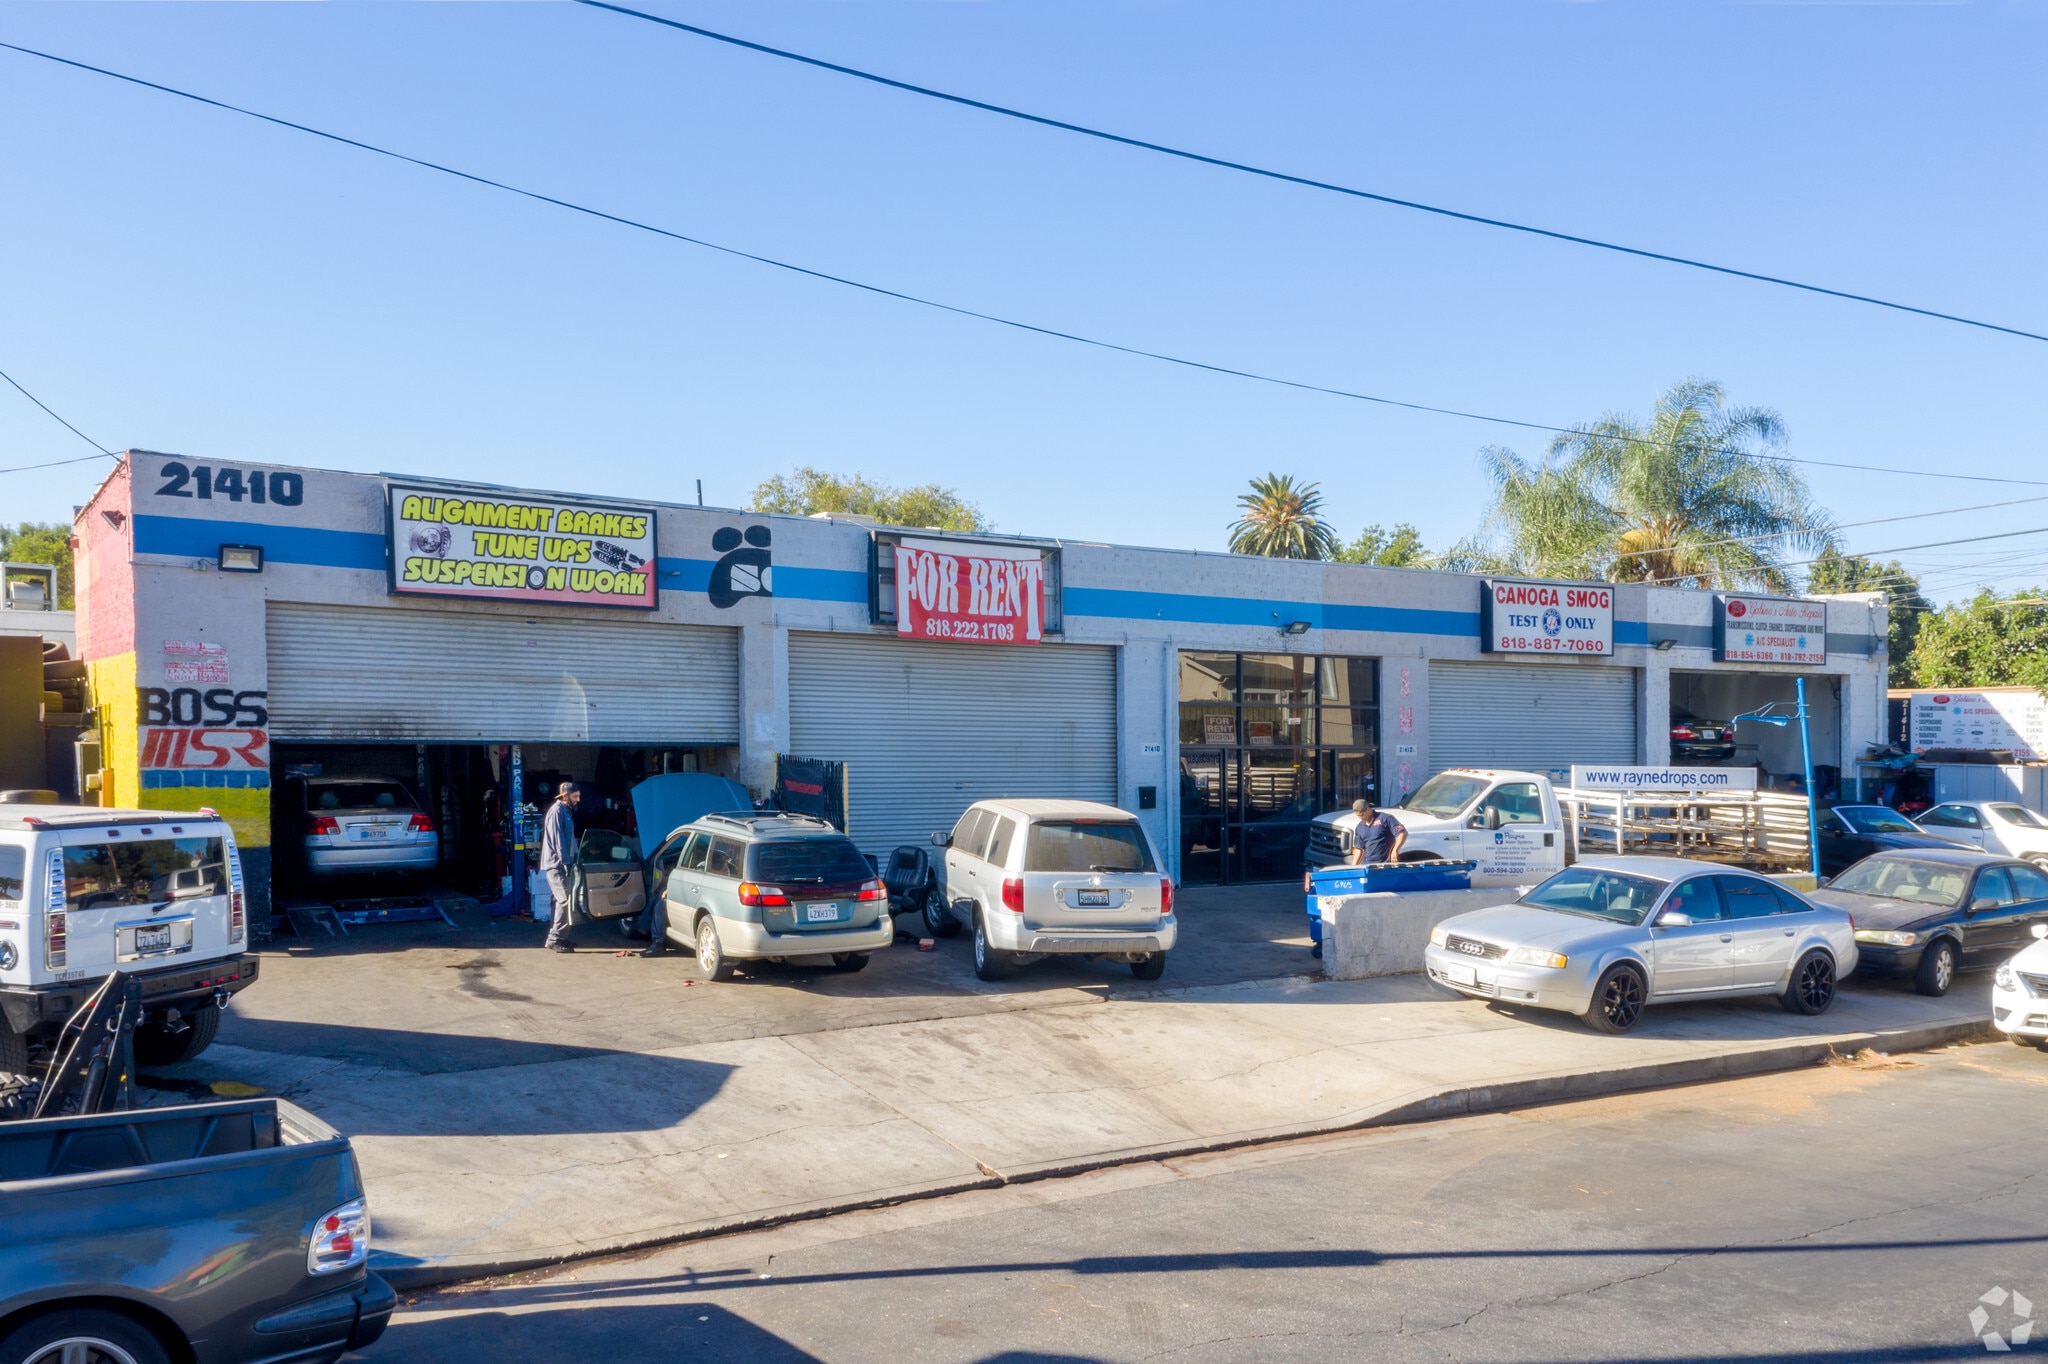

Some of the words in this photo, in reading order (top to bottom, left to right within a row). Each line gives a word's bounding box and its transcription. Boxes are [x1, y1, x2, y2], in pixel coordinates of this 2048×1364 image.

[155, 461, 304, 507] 21410
[401, 494, 554, 533] ALIGNMENT
[555, 508, 647, 540] BRAKES
[472, 531, 540, 560] TUNE
[542, 536, 592, 563] UPS
[402, 556, 569, 592] SUSPENSION
[570, 567, 648, 596] WORK
[896, 546, 959, 633] FOR
[968, 558, 1043, 641] RENT
[1495, 585, 1560, 607] CANOGA
[1566, 589, 1609, 609] SMOG
[1508, 614, 1538, 627] TEST
[1565, 616, 1596, 630] ONLY
[1779, 604, 1797, 617] Auto
[1799, 604, 1823, 622] Repair
[925, 617, 1014, 641] 818.222.1703
[1501, 637, 1604, 652] 818-887-7060
[1756, 636, 1766, 646] A/C
[1767, 637, 1796, 647] SPECIALIST
[1726, 650, 1773, 660] 818-854-6360
[1780, 652, 1824, 662] 818-792-2159
[139, 687, 268, 727] BOSS
[1207, 725, 1233, 733] RENT
[1209, 717, 1230, 725] FOR
[1900, 699, 1909, 742] 21412
[140, 728, 268, 769] MSR
[1144, 745, 1161, 753] 21410
[1586, 770, 1728, 787] www.raynedrops.com
